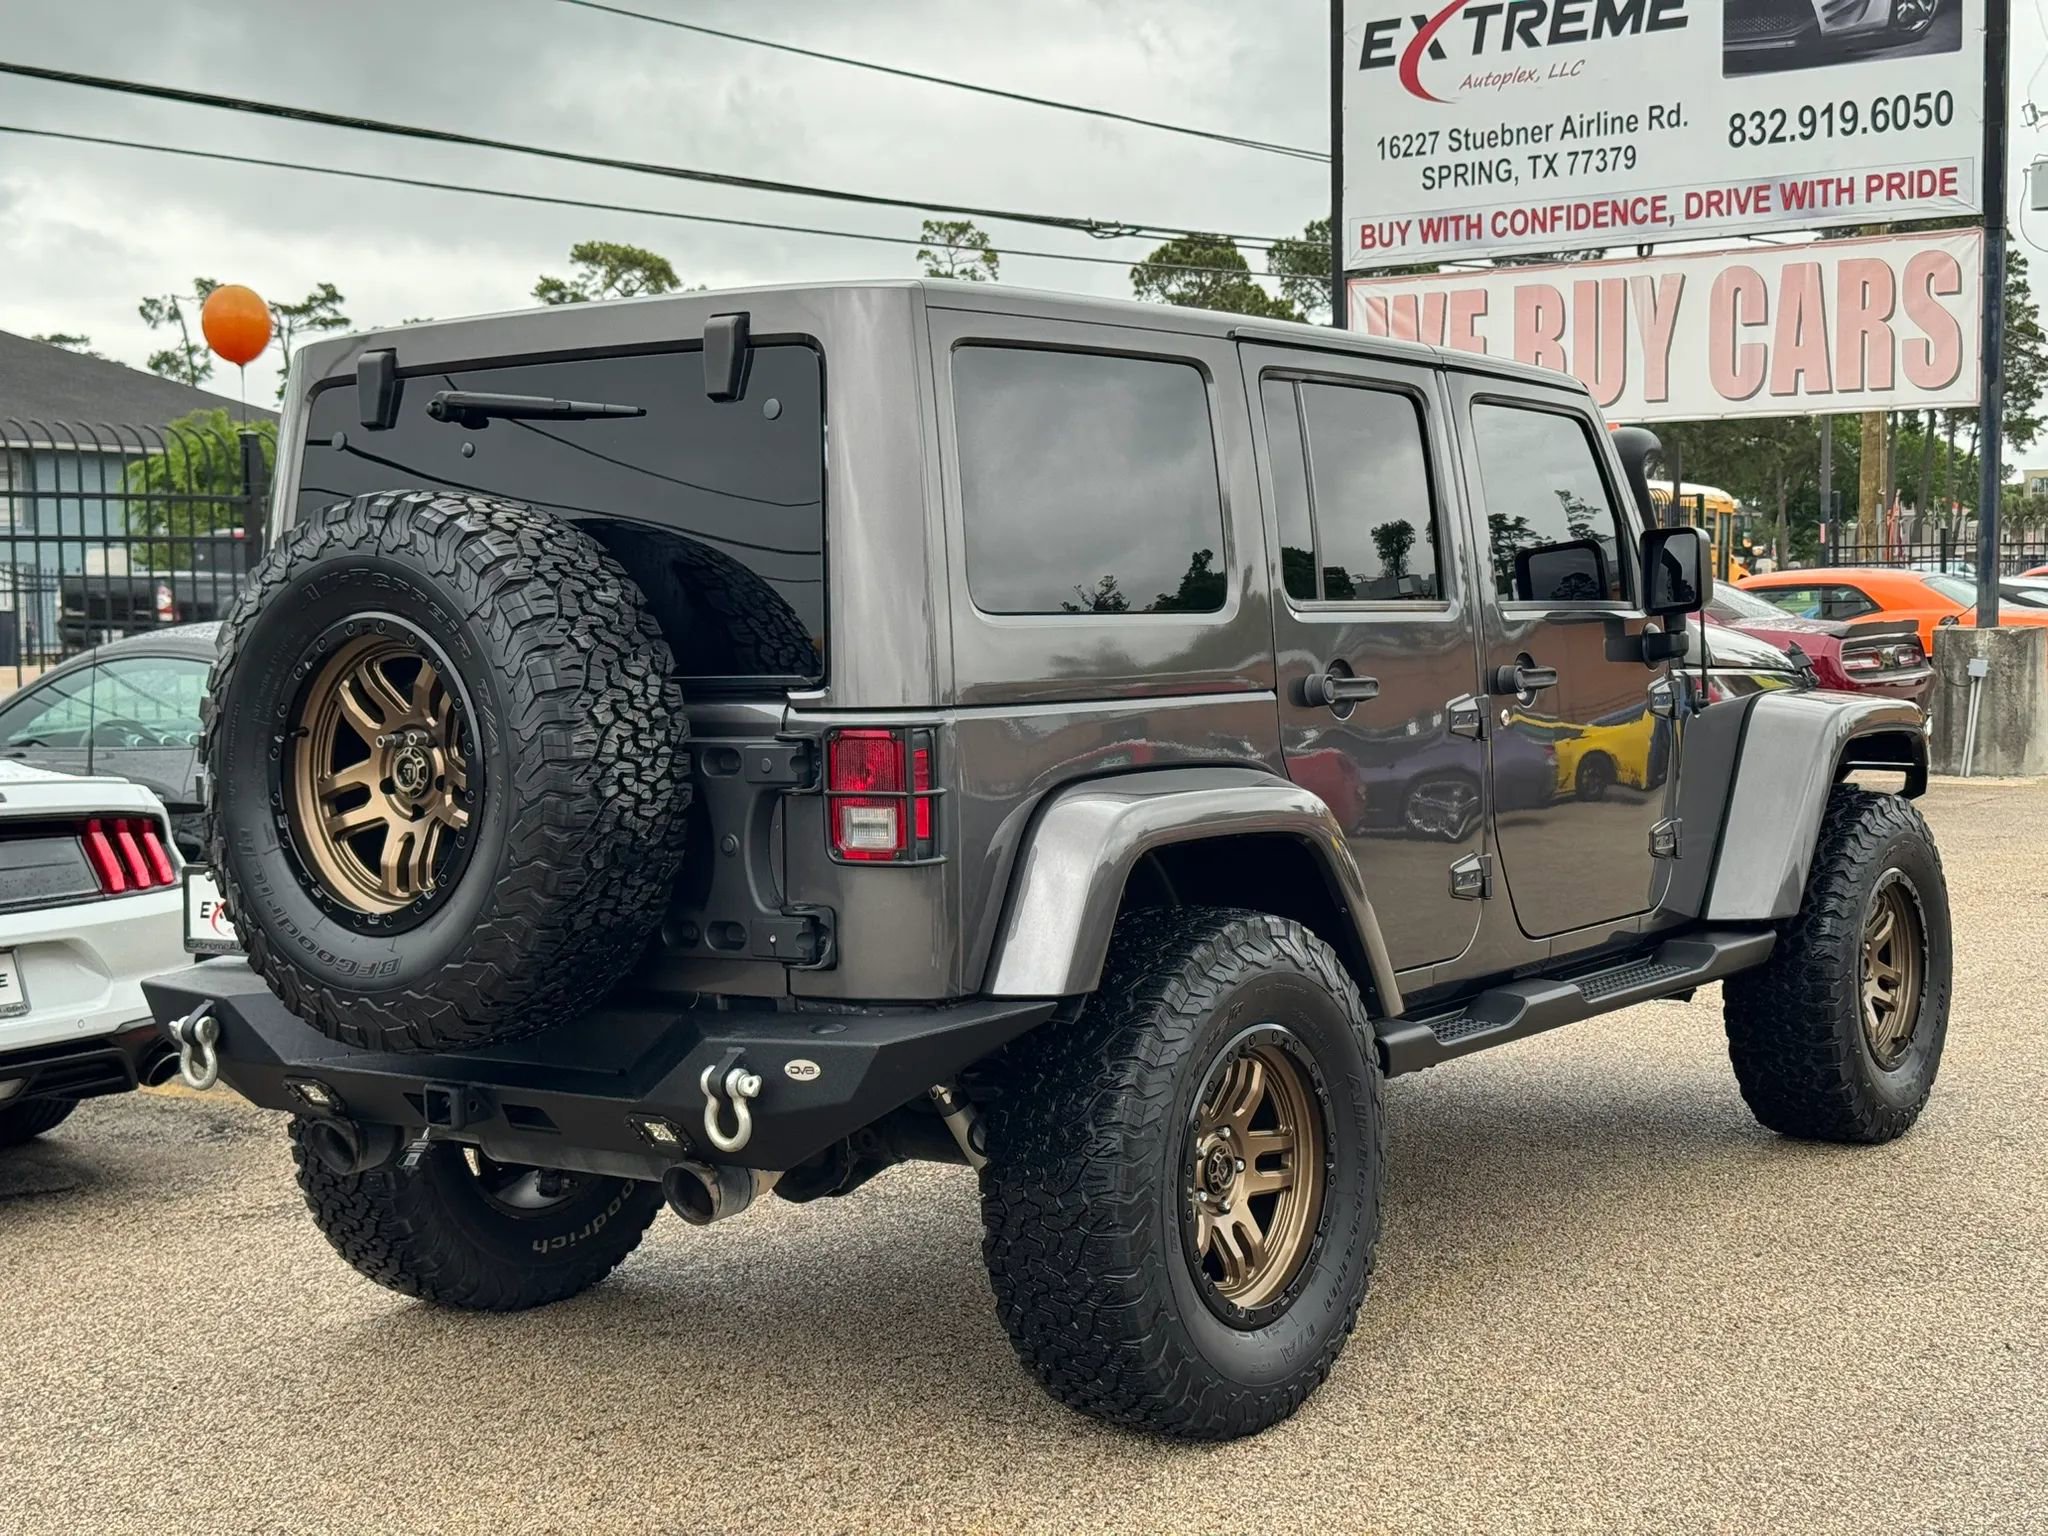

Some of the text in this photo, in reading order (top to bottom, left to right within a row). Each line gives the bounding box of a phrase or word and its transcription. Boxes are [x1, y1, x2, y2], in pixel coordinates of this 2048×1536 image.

[1359, 0, 1688, 70] EXTREME
[1459, 59, 1586, 91] Autoplex, LLC
[1376, 102, 1689, 160] 16227 Stuebner Airline Rd.
[1728, 90, 1953, 148] 832.919.6050
[1421, 145, 1637, 190] SPRING, TX 77379
[1360, 167, 1958, 250] BUY WITH CONFIDENCE, DRIVE WITH PRIDE
[1514, 273, 1686, 409] BUY
[1708, 249, 1963, 401] CARS
[237, 826, 403, 979] BFGoodrich
